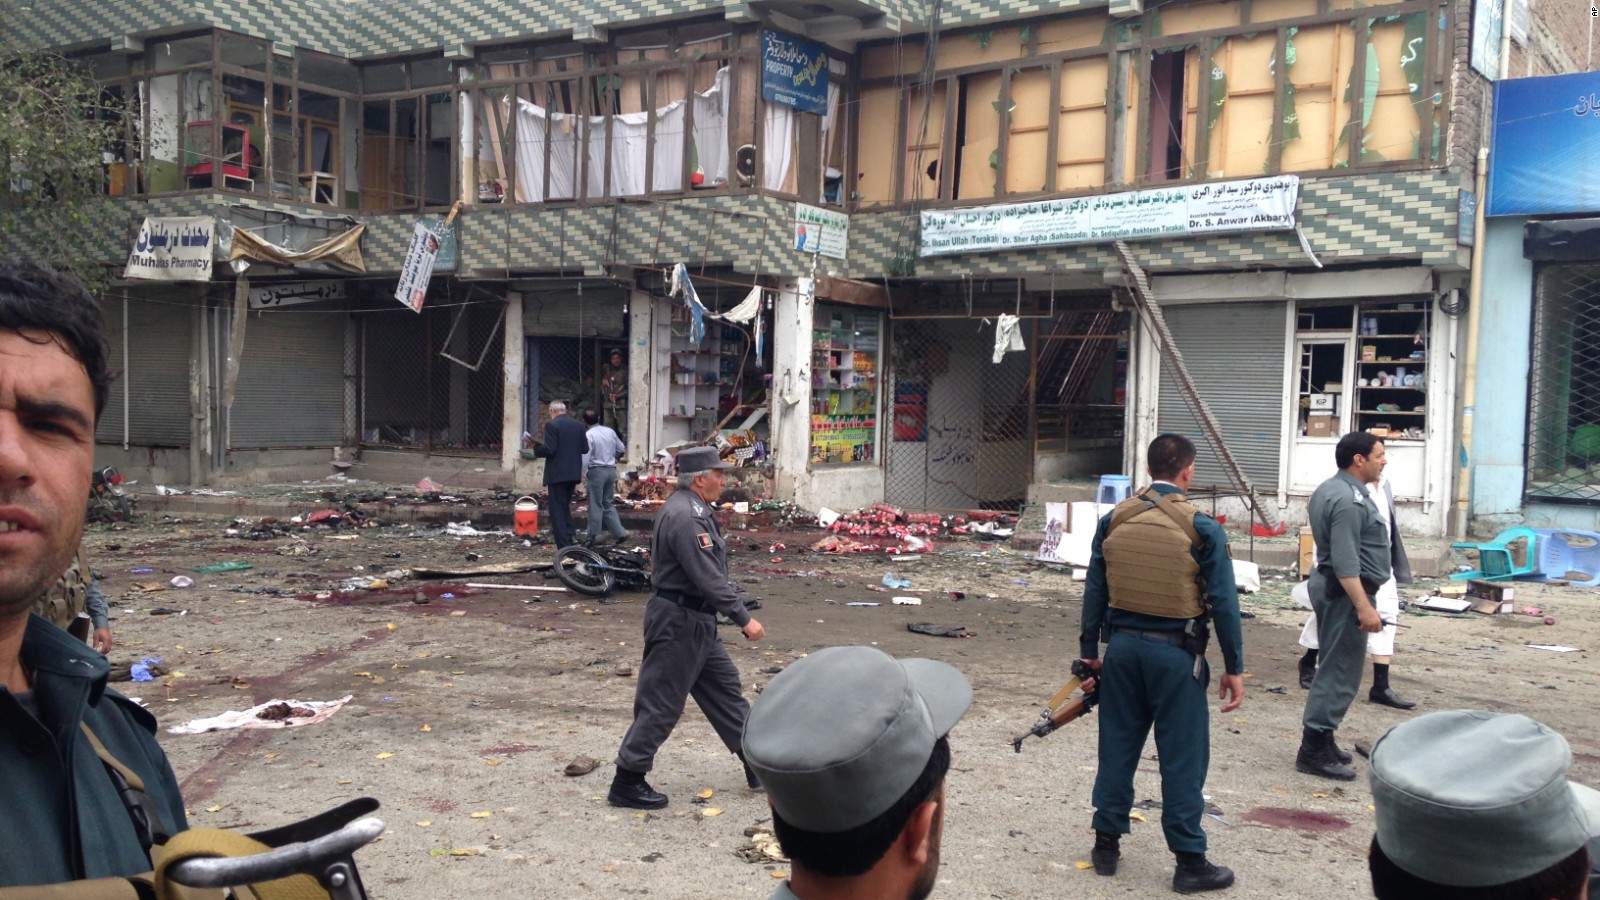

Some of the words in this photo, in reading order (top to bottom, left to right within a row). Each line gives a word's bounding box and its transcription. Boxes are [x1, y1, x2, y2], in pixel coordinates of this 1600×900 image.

[765, 59, 793, 78] PROPERTY
[1189, 219, 1202, 228] Dr.
[1205, 218, 1214, 227] S.
[1217, 216, 1248, 226] Anwar
[1002, 236, 1012, 244] Dr.
[1013, 235, 1029, 243] Sher
[1030, 234, 1047, 243] Agha
[1091, 230, 1100, 238] Dr.
[1101, 228, 1130, 239] Sediqullah
[921, 239, 931, 248] Dr.
[951, 236, 969, 246] Ullah
[171, 256, 209, 270] Pharmacy
